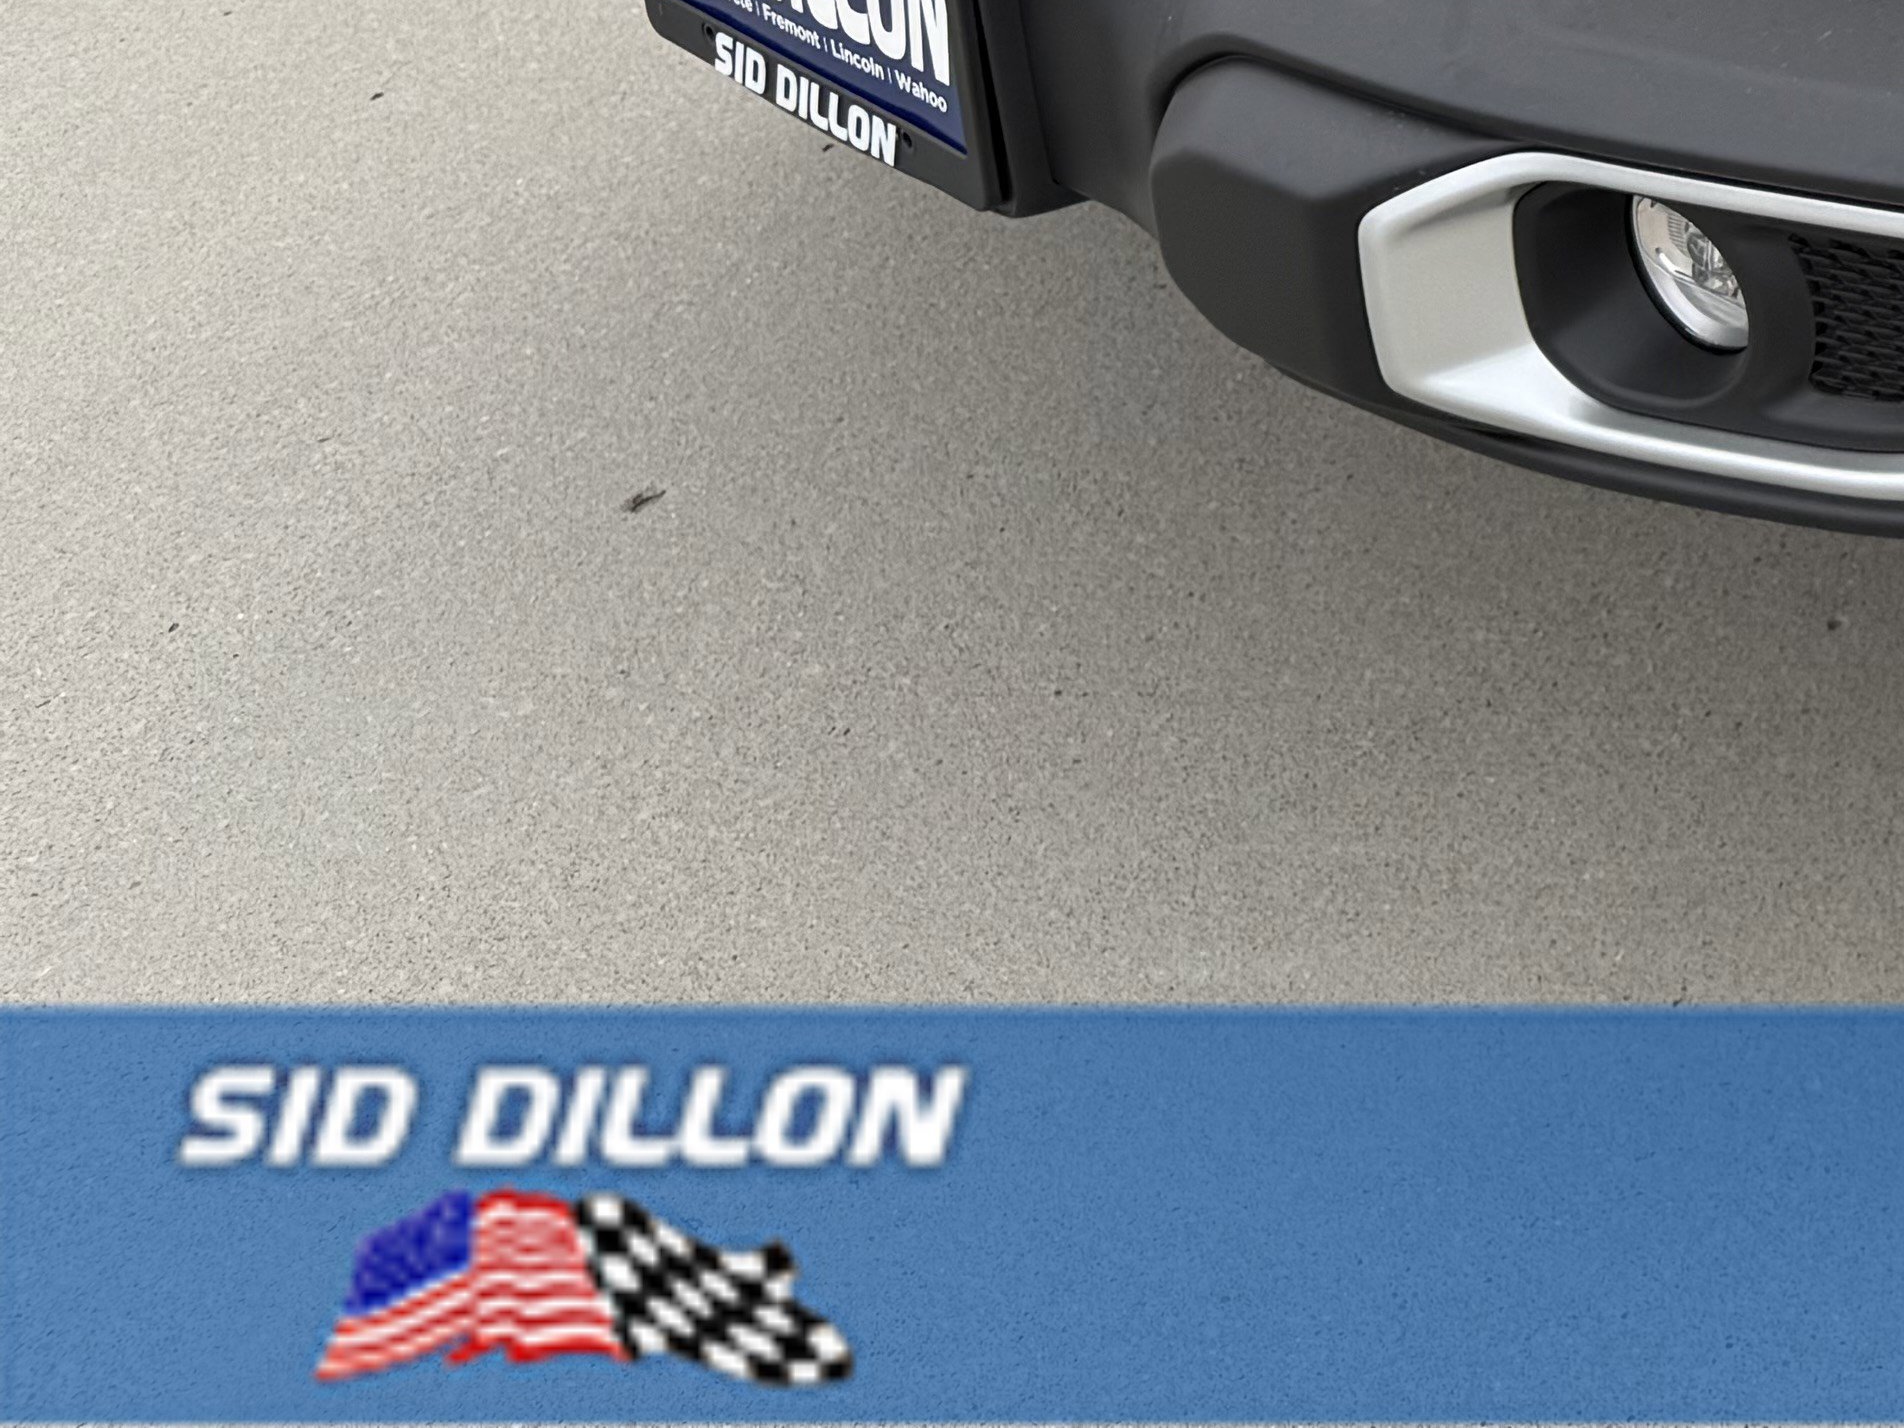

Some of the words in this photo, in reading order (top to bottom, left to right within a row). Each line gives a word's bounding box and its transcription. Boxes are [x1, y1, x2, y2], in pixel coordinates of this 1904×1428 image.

[714, 32, 767, 96] SID
[775, 69, 898, 167] DILLON
[762, 3, 821, 49] Fremont
[829, 38, 885, 81] Lincoln
[894, 69, 948, 113] Wahoo
